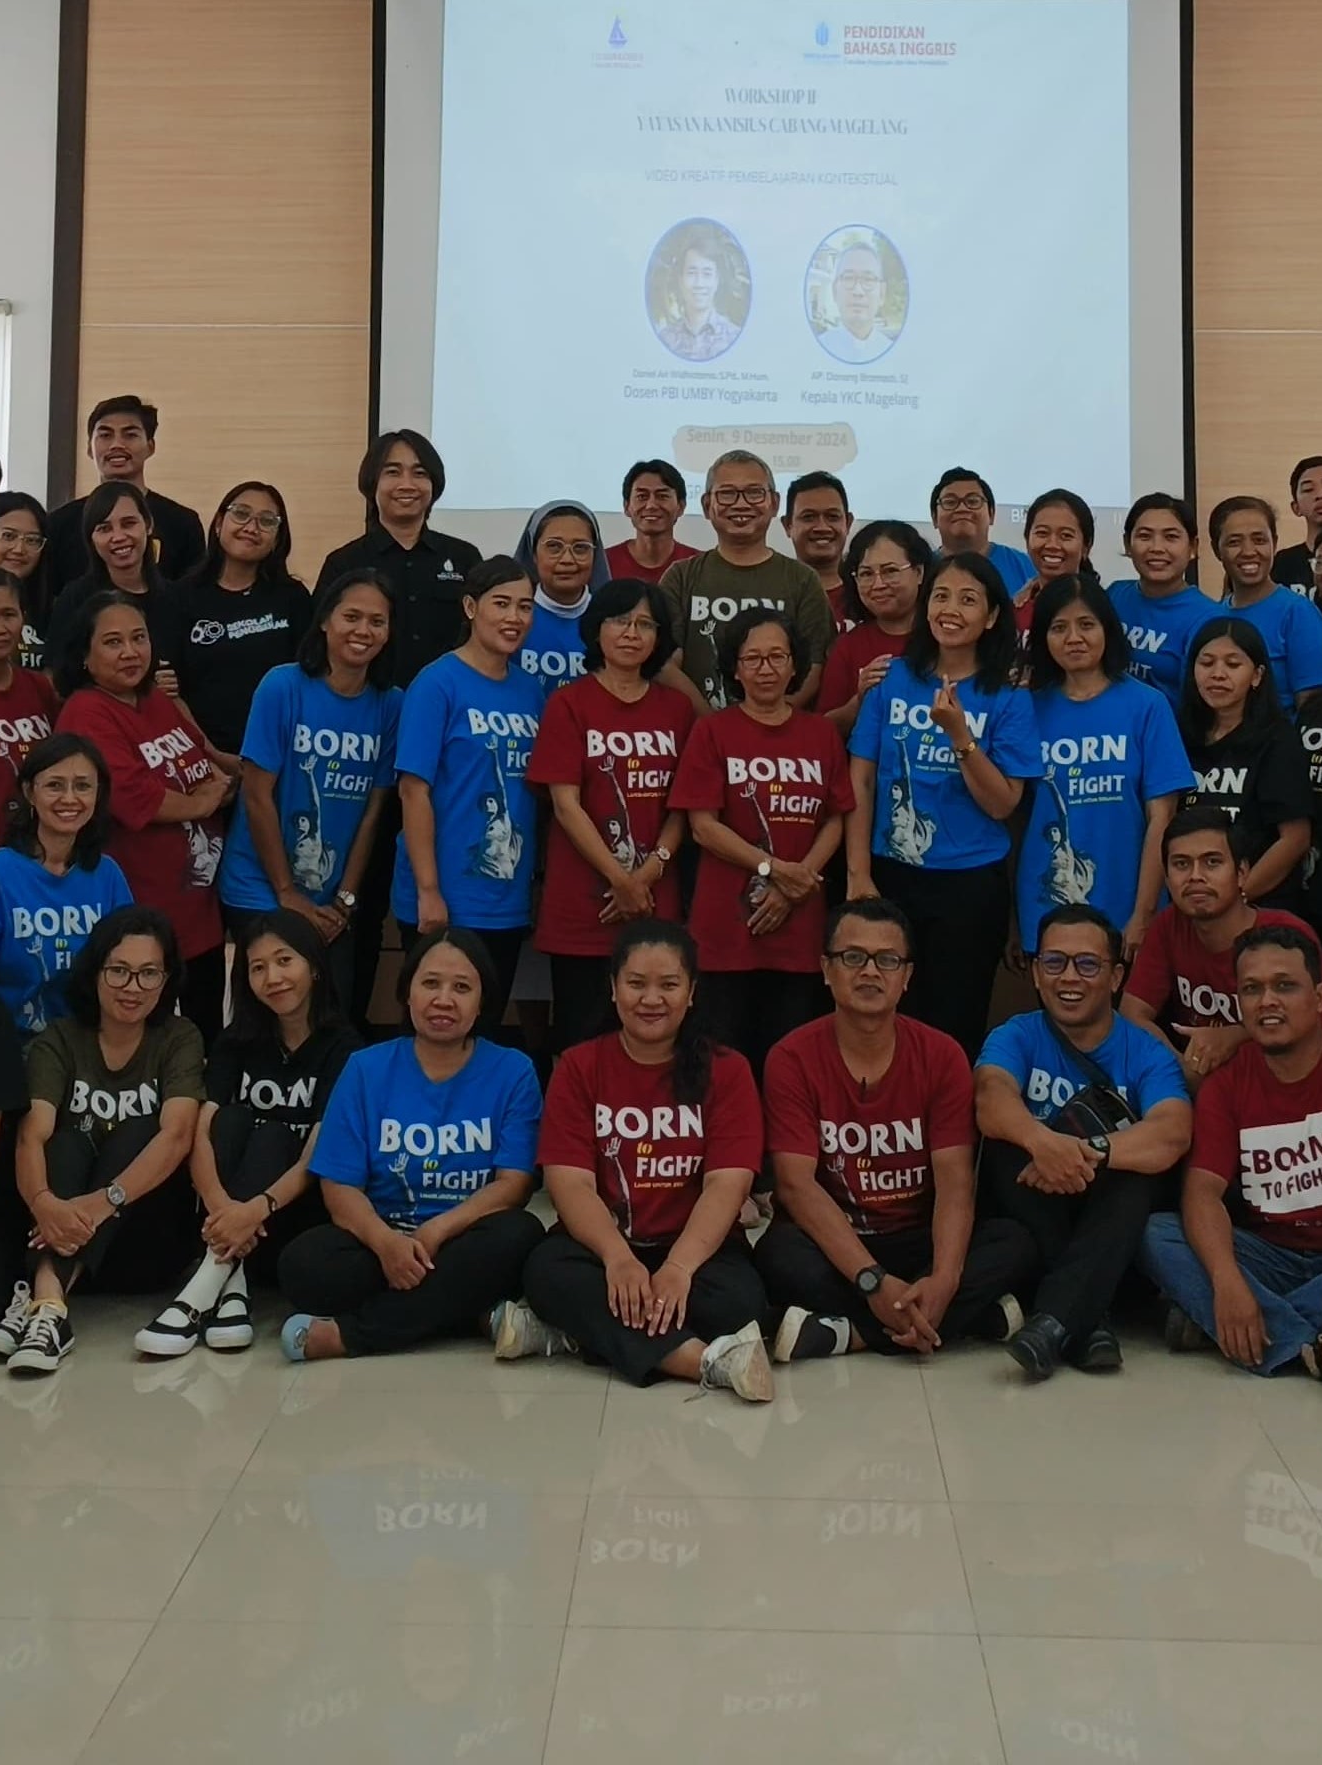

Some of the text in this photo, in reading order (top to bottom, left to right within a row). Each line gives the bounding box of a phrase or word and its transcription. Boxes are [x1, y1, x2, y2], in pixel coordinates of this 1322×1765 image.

[843, 25, 925, 39] PENDIDIKAN
[843, 41, 958, 57] BAHASA INGGRIS
[724, 87, 817, 105] WORKSHOP II
[637, 115, 908, 135] YAYASAN KANISIUS CABANG MAGELANG
[645, 169, 899, 186] VIDEO KREATIF PEMBELAJARAN KONTEKSTUAL
[624, 385, 778, 404] Dosen PBI UMBY Yogyakarta
[800, 391, 920, 409] Kepala YKC Magelang
[732, 430, 741, 444] 9
[744, 431, 813, 446] Desember
[816, 433, 848, 447] 2024
[521, 649, 589, 676] BOR
[467, 708, 540, 739] BORN
[889, 697, 988, 740] BON
[139, 726, 196, 769] BORN
[293, 723, 381, 762] BORN
[506, 738, 518, 750] to
[587, 729, 678, 758] BORN
[921, 733, 935, 744] to
[506, 751, 529, 768] FIG
[1040, 734, 1127, 766] BORN
[185, 758, 212, 784] FIGH
[327, 760, 340, 770] to
[627, 758, 640, 770] to
[727, 756, 823, 785] BORN
[1068, 766, 1081, 777] to
[770, 783, 783, 794] to
[1068, 775, 1126, 796] FIGHT
[769, 794, 823, 817] FIGHT
[69, 1078, 160, 1122] BORN
[595, 1103, 704, 1141] BORN
[377, 1117, 493, 1156] BORN
[820, 1117, 924, 1157] BORN
[636, 1140, 653, 1155] to
[423, 1157, 439, 1170] to
[635, 1155, 704, 1178] FIGHT
[856, 1156, 872, 1170] to
[422, 1167, 492, 1191] FIGHT
[859, 1165, 927, 1192] FIGHT
[1261, 1182, 1283, 1201] TO
